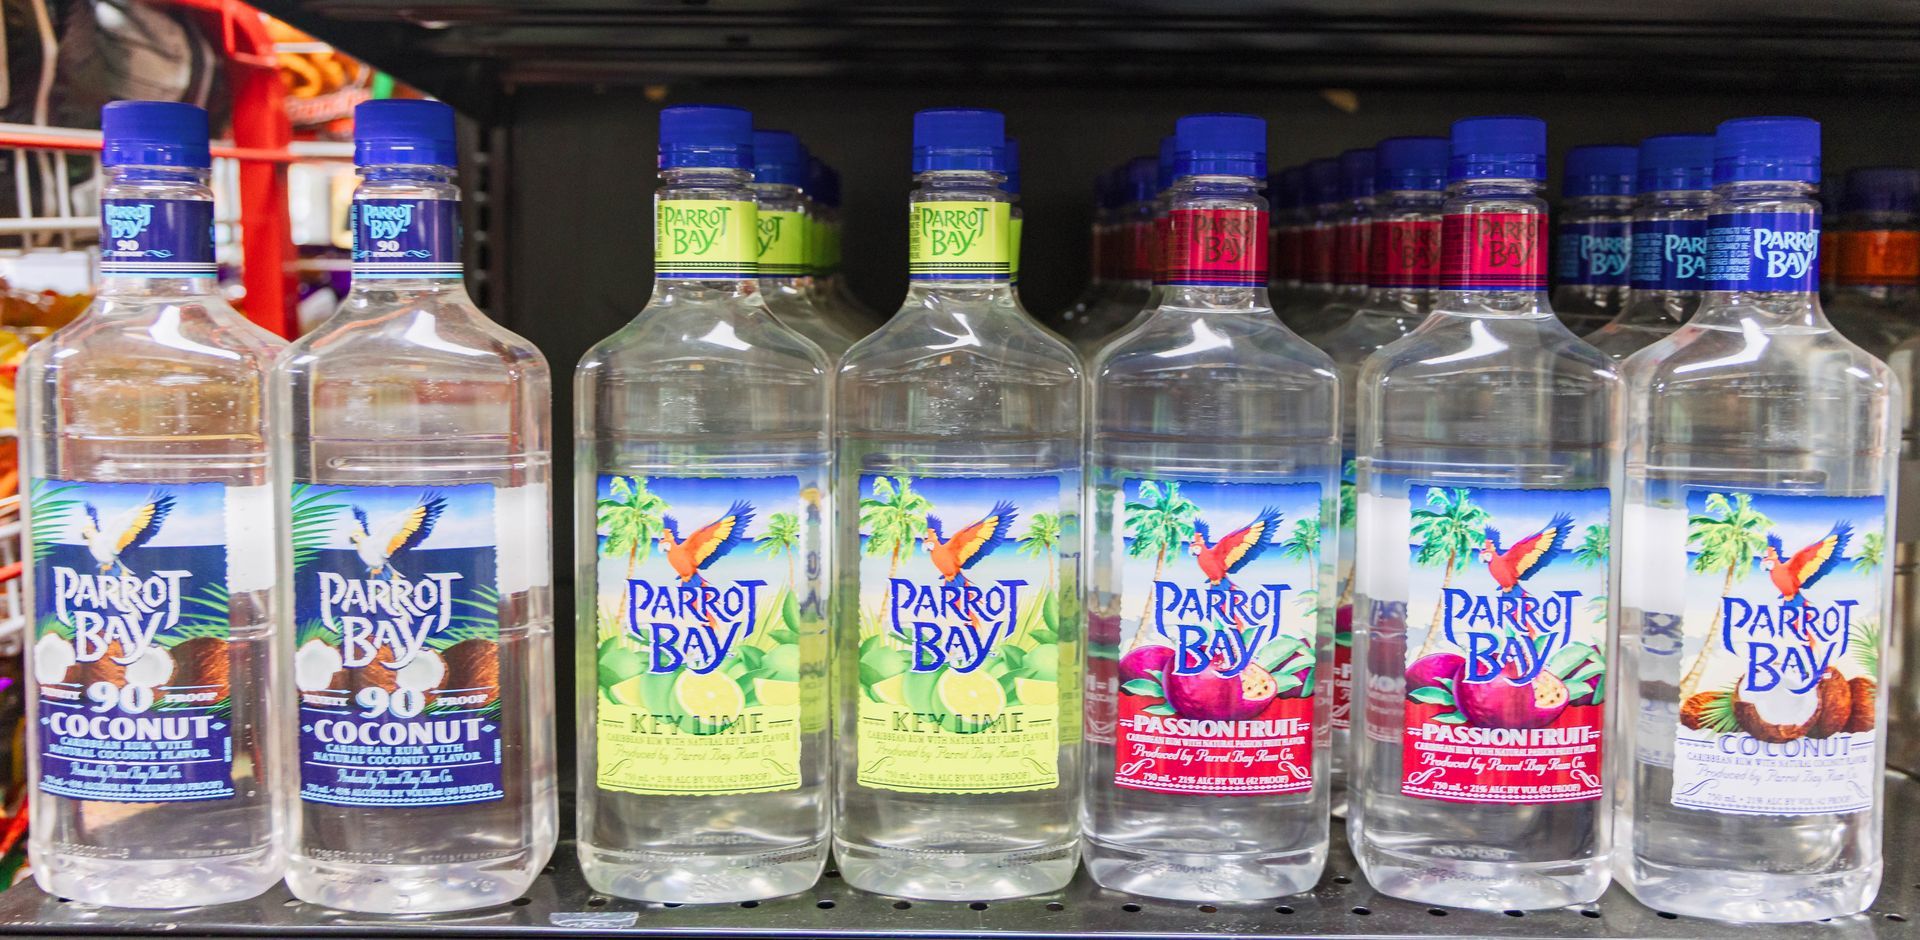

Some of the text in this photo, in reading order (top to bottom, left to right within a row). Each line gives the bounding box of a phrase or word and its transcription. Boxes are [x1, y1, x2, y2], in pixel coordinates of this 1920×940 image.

[104, 204, 155, 226] PARROT
[362, 204, 415, 226] PARROT
[664, 206, 731, 237] PARROT
[921, 207, 989, 238] PARROT
[111, 219, 145, 239] BAY
[370, 219, 404, 239] BAY
[673, 228, 718, 255] BAY
[757, 217, 784, 242] ROT
[931, 229, 976, 256] BAY
[117, 240, 139, 251] 90
[377, 240, 399, 251] 90
[1204, 236, 1247, 263] BAY
[1489, 241, 1535, 268] BAY
[1665, 234, 1707, 262] PAR
[1754, 228, 1820, 260] PARROT
[1590, 253, 1632, 276] BAY
[1767, 250, 1814, 279] BAY
[53, 567, 193, 630] PARROT
[318, 572, 464, 633] PARROT
[625, 579, 768, 638] PARROT
[888, 577, 1029, 639] PARROT
[1154, 580, 1291, 641] PARROT
[1441, 587, 1583, 648] PARROT
[1722, 596, 1859, 657] PARROT
[74, 611, 165, 665] BAY
[342, 616, 437, 670] BAY
[649, 622, 742, 675] BAY
[912, 621, 1003, 674] BAY
[1174, 624, 1268, 677] BAY
[1463, 632, 1559, 686] BAY
[1745, 641, 1837, 694] BAY
[87, 681, 154, 715] 90
[355, 686, 426, 719] 90
[436, 694, 488, 706] PROOF
[50, 712, 214, 740] COCONUT
[314, 718, 485, 745] COCONUT
[631, 713, 763, 736] KEY LIME
[893, 712, 1023, 735] KEY LIME
[1133, 715, 1301, 737] PASSION FRUIT
[1422, 723, 1592, 747] PASSION FRUIT
[313, 752, 365, 764] NATURAL
[367, 756, 430, 765] COCONUT
[432, 752, 482, 763] FLAVOR
[326, 744, 464, 755] CARIBBEAN RUM WITH
[614, 744, 656, 758] Produced
[658, 750, 670, 764] by
[673, 748, 705, 760] Parrot
[875, 742, 919, 758] Produced
[921, 748, 932, 762] by
[936, 746, 968, 759] Parrot
[1132, 744, 1294, 768] Produced by Parrot Bay Rum Co.
[1687, 752, 1732, 765] CARIBBEAN
[1719, 735, 1852, 757] COCONUT
[1421, 752, 1586, 776] Produced by Parrot Bay Rum Co.
[1142, 772, 1157, 782] 750
[1178, 776, 1196, 784] 21%
[1215, 777, 1228, 785] BY
[1228, 777, 1246, 785] VOL
[1246, 777, 1258, 786] (42
[1259, 775, 1289, 784] PROOF)
[1432, 781, 1447, 791] 750
[1448, 784, 1462, 792] mL
[1470, 785, 1488, 793] 21%
[1489, 785, 1508, 793] ALC
[1508, 786, 1520, 794] BY
[1521, 786, 1538, 794] VOL
[1552, 783, 1581, 793] PROOF)
